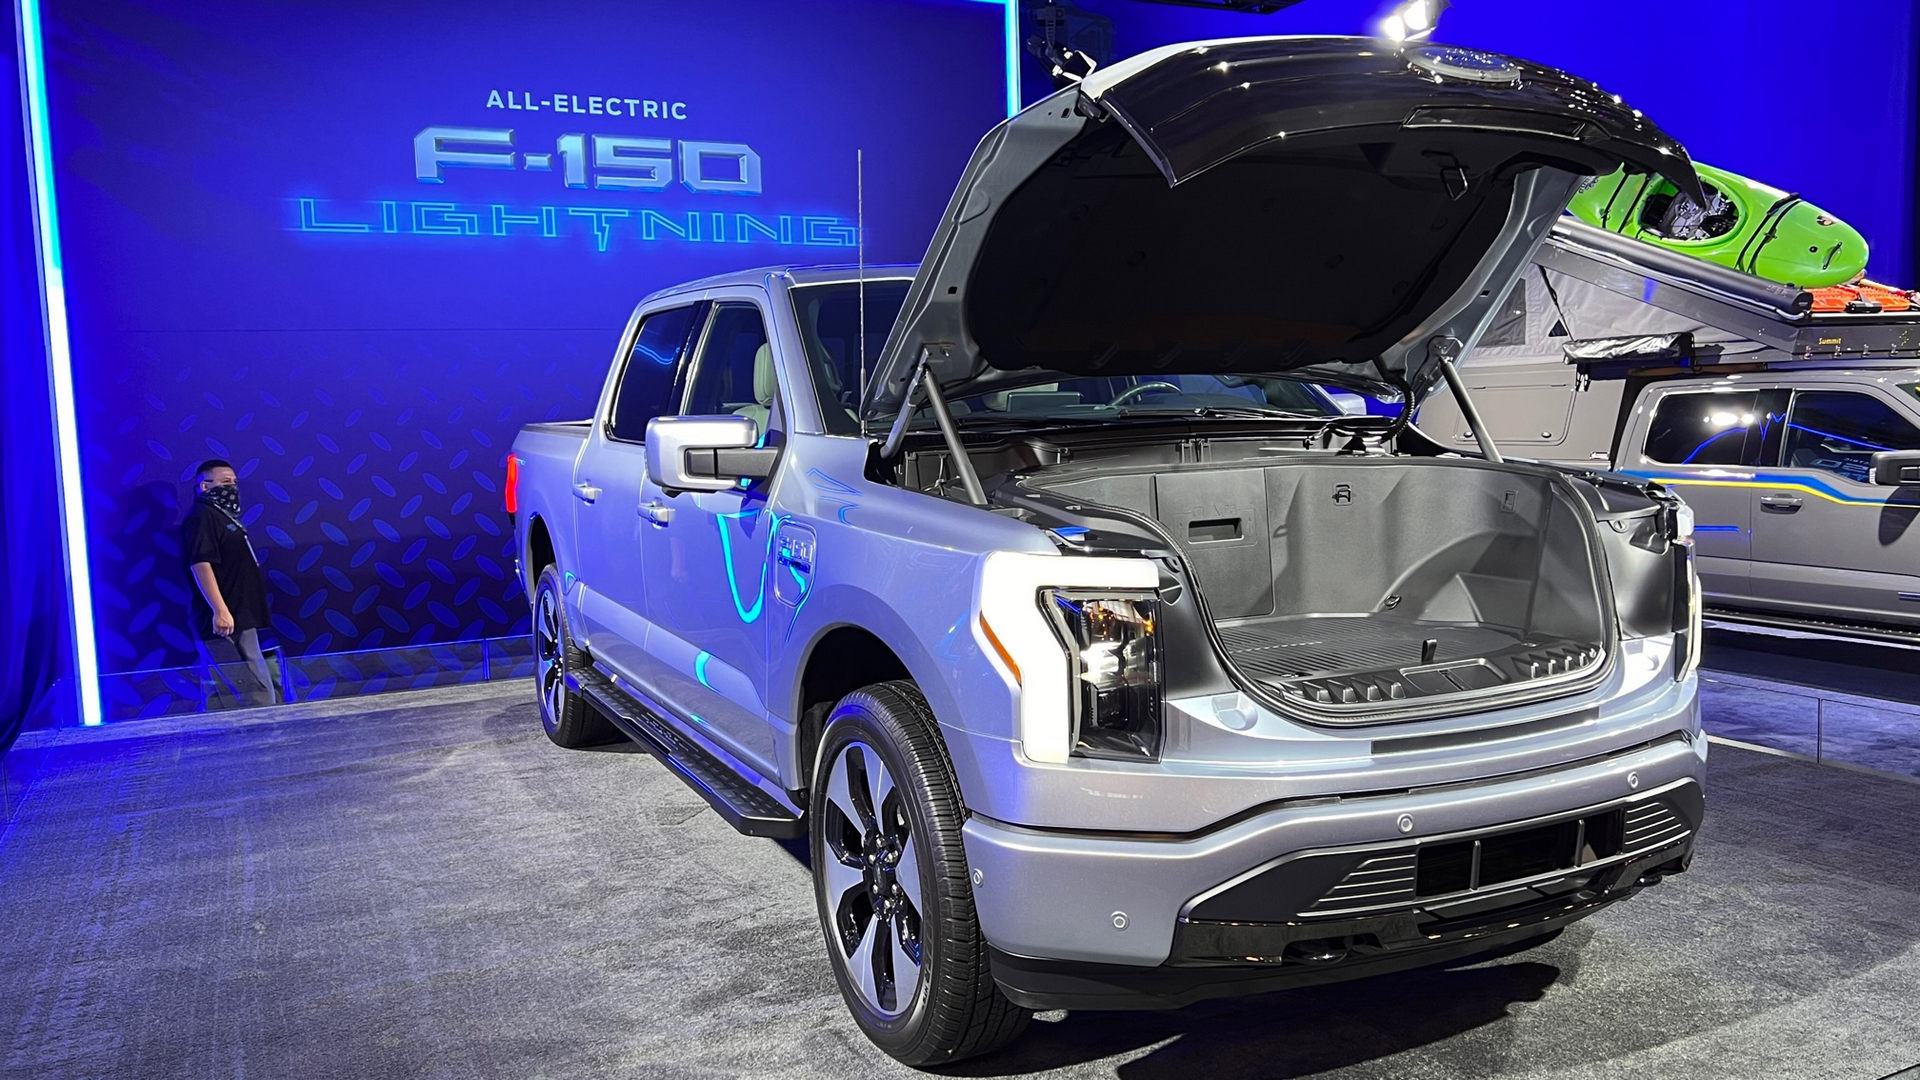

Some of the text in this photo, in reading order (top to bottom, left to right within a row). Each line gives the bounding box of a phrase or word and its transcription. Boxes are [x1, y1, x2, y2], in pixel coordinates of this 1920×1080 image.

[486, 89, 688, 121] ALL-ELECTRIC
[414, 127, 762, 195] F-150
[299, 198, 857, 252] LIGHTNING
